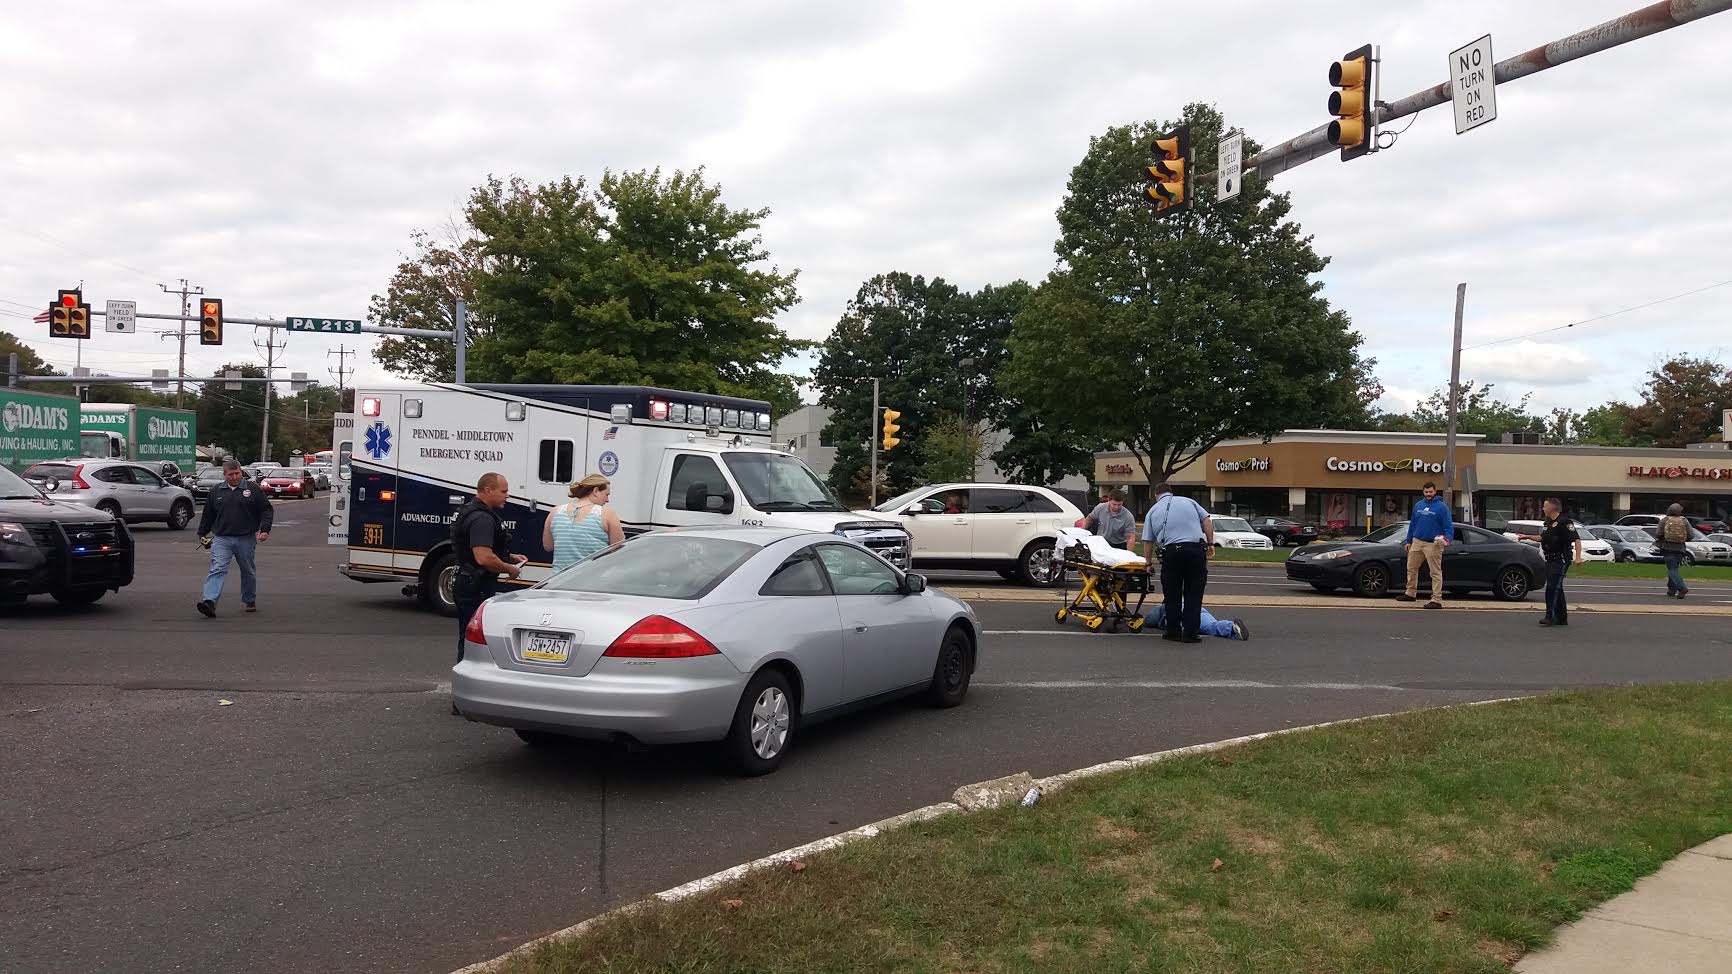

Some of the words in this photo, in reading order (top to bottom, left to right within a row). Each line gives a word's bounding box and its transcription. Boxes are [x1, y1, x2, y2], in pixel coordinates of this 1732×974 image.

[1459, 48, 1481, 73] NO
[1459, 68, 1485, 91] TURN
[1466, 88, 1481, 105] ON
[1465, 105, 1485, 124] RED
[293, 319, 315, 330] PA
[321, 320, 355, 332] 213
[412, 429, 449, 440] PENNDEL
[456, 430, 514, 442] MIDDLETOWN
[20, 437, 27, 450] &
[420, 447, 471, 460] EMERGENCY
[474, 450, 503, 462] SQUAD
[1216, 458, 1239, 472] Cosmo
[1251, 457, 1270, 471] Prof
[1326, 456, 1384, 472] Cosmo
[1629, 465, 1688, 478] PLATO'S
[401, 512, 440, 524] ADVANCED
